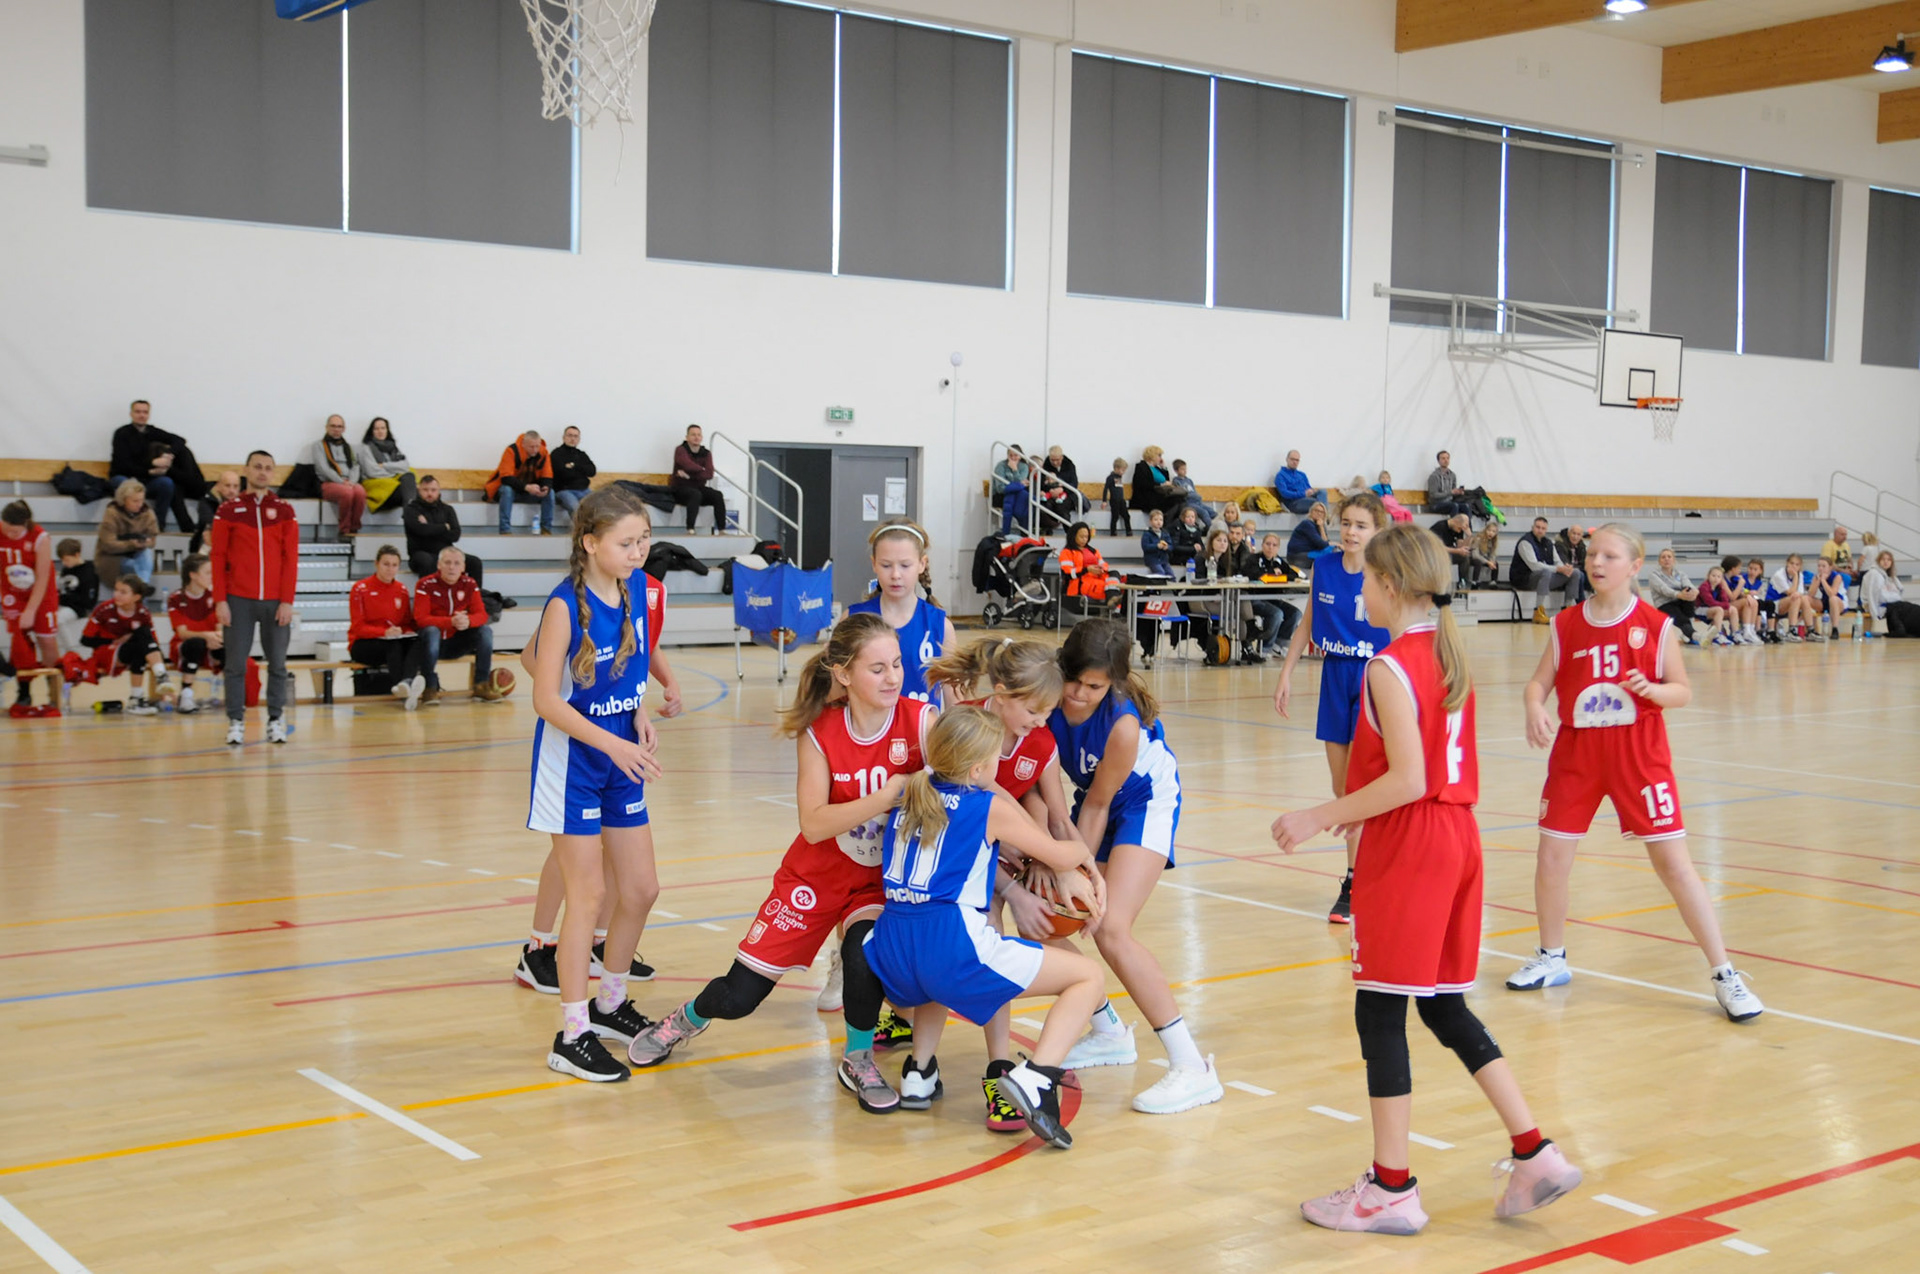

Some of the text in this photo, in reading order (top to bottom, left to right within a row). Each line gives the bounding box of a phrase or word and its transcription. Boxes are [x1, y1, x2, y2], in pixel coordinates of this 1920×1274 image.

[1354, 594, 1370, 622] 1
[918, 630, 934, 665] 6
[1322, 637, 1357, 656] huber
[1588, 644, 1620, 679] 15
[589, 695, 639, 717] huber
[1640, 781, 1675, 819] 15
[772, 918, 790, 932] PZU
[780, 904, 804, 921] Dobra
